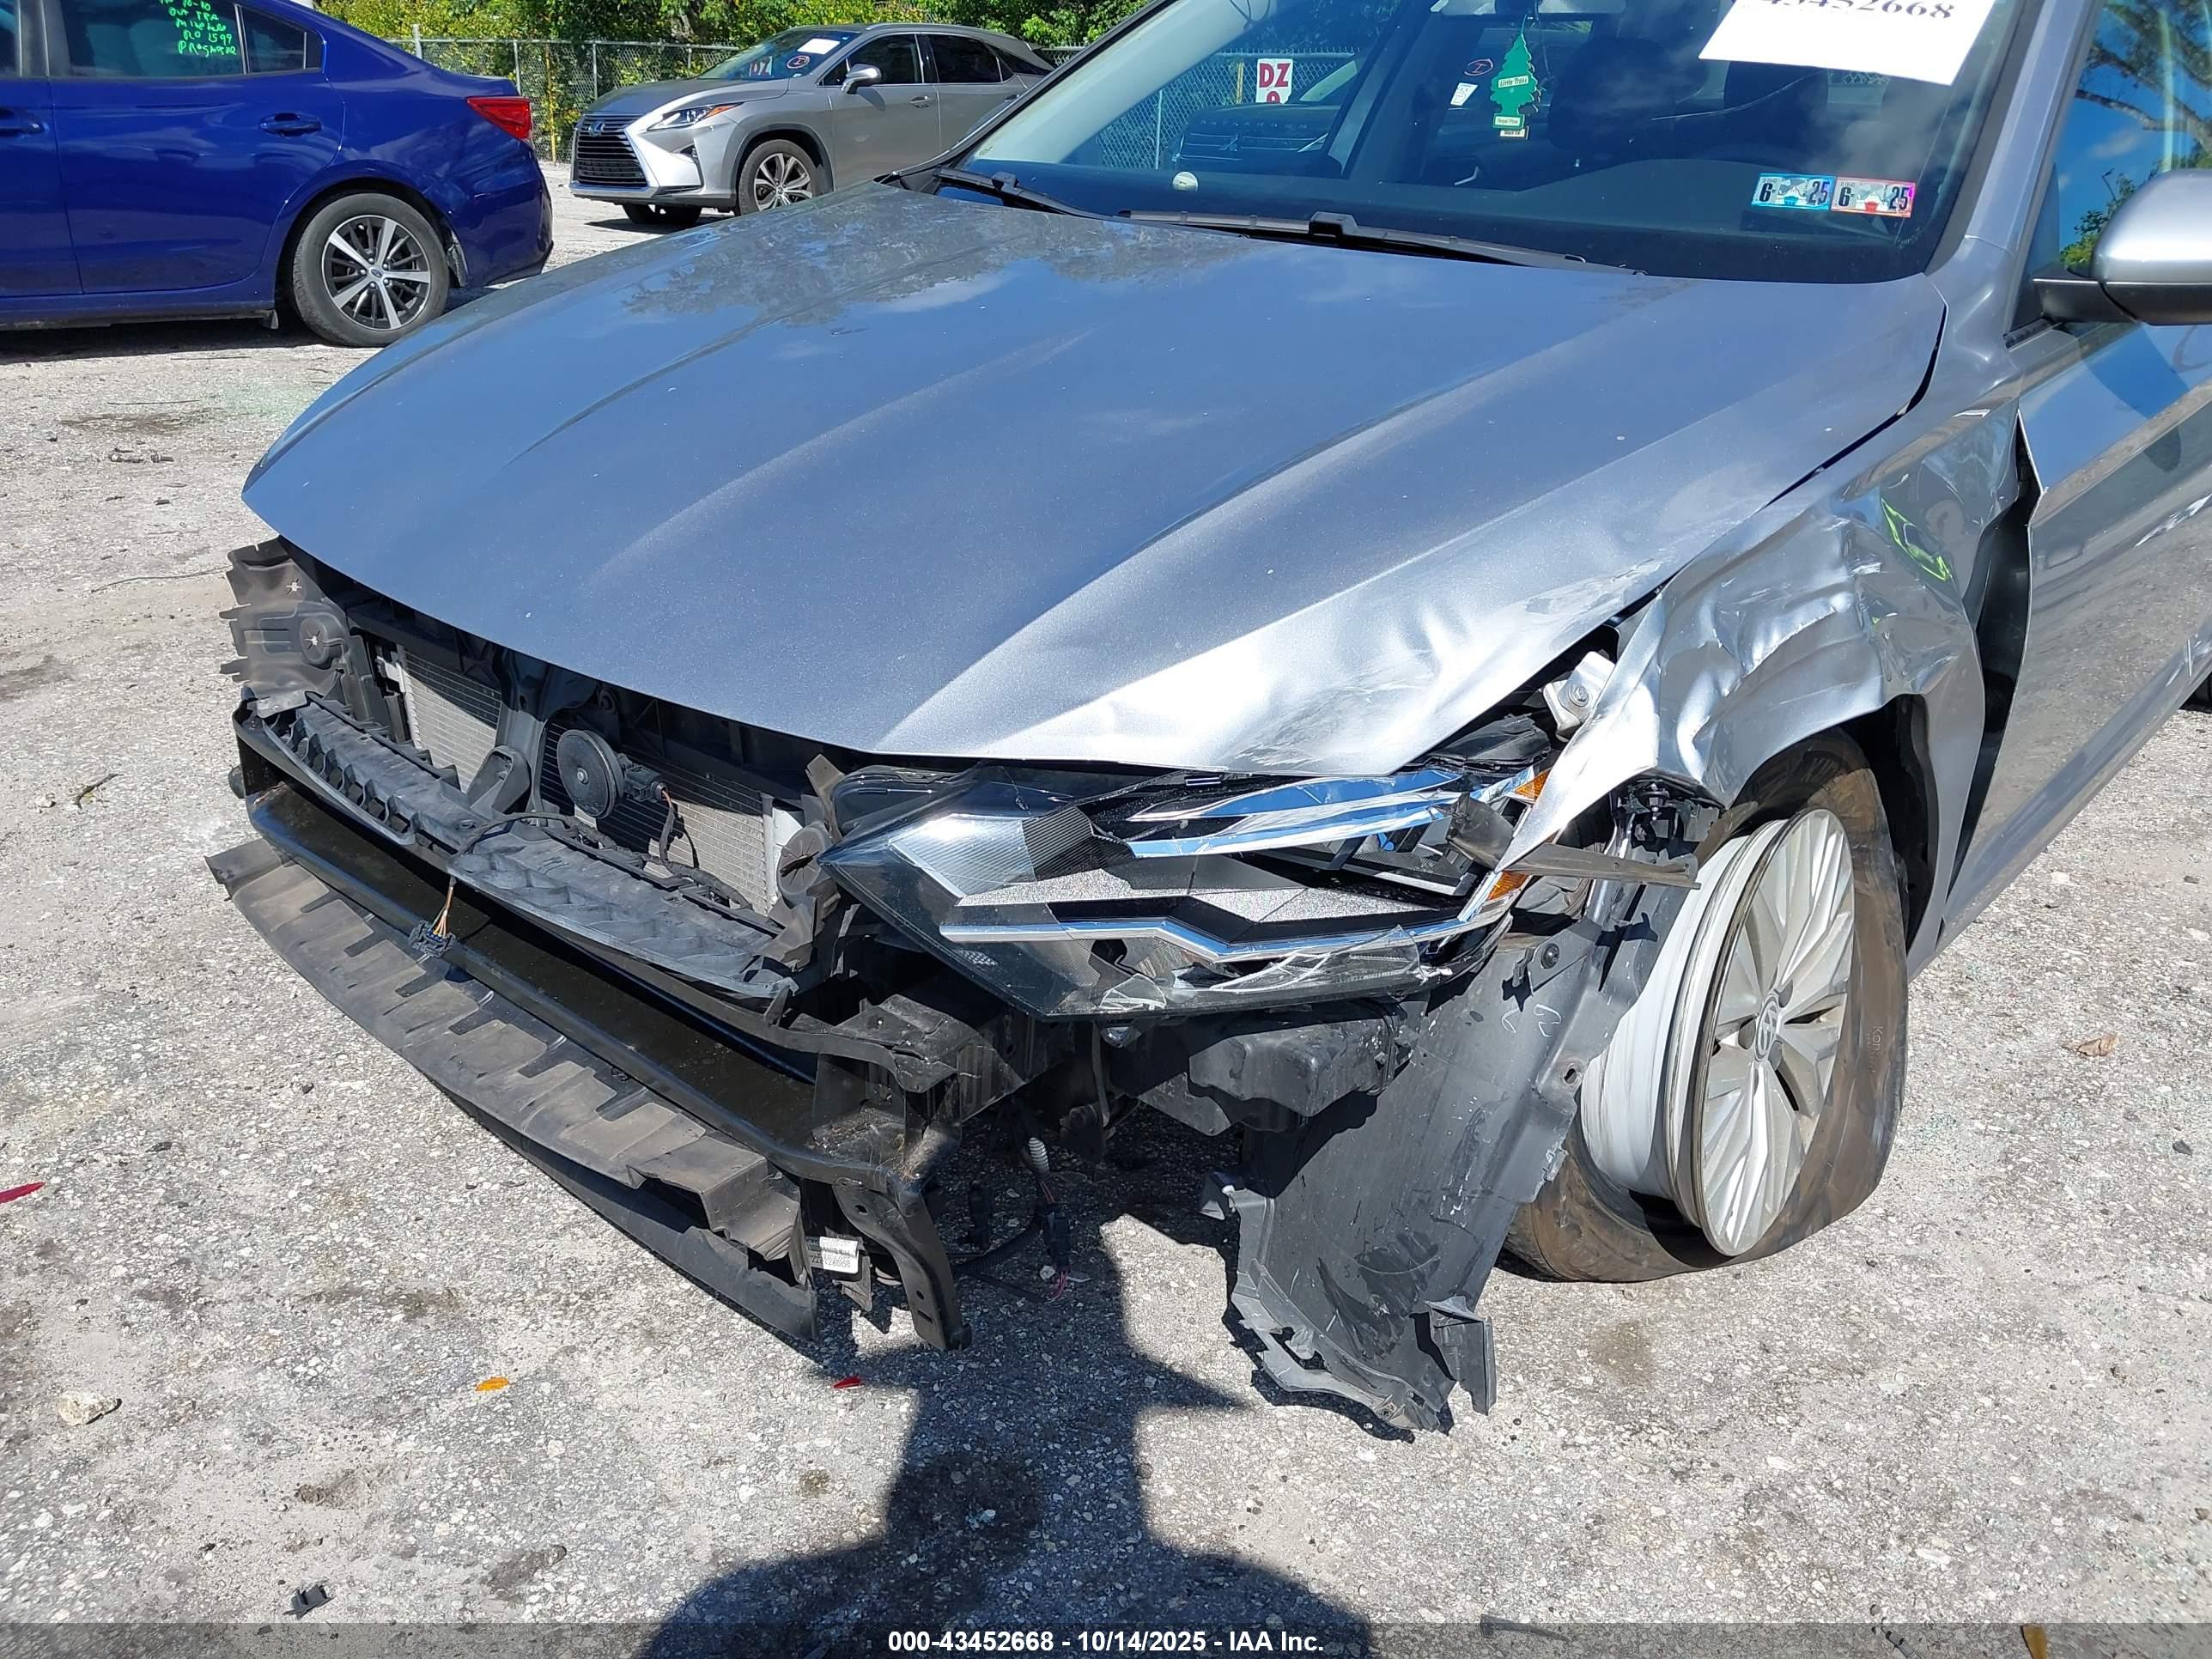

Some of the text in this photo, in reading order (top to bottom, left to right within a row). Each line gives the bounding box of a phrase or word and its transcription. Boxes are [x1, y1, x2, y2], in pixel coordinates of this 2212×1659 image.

[1259, 63, 1291, 88] DZ
[1759, 180, 1830, 205] 6 25
[1838, 185, 1910, 210] 6 25
